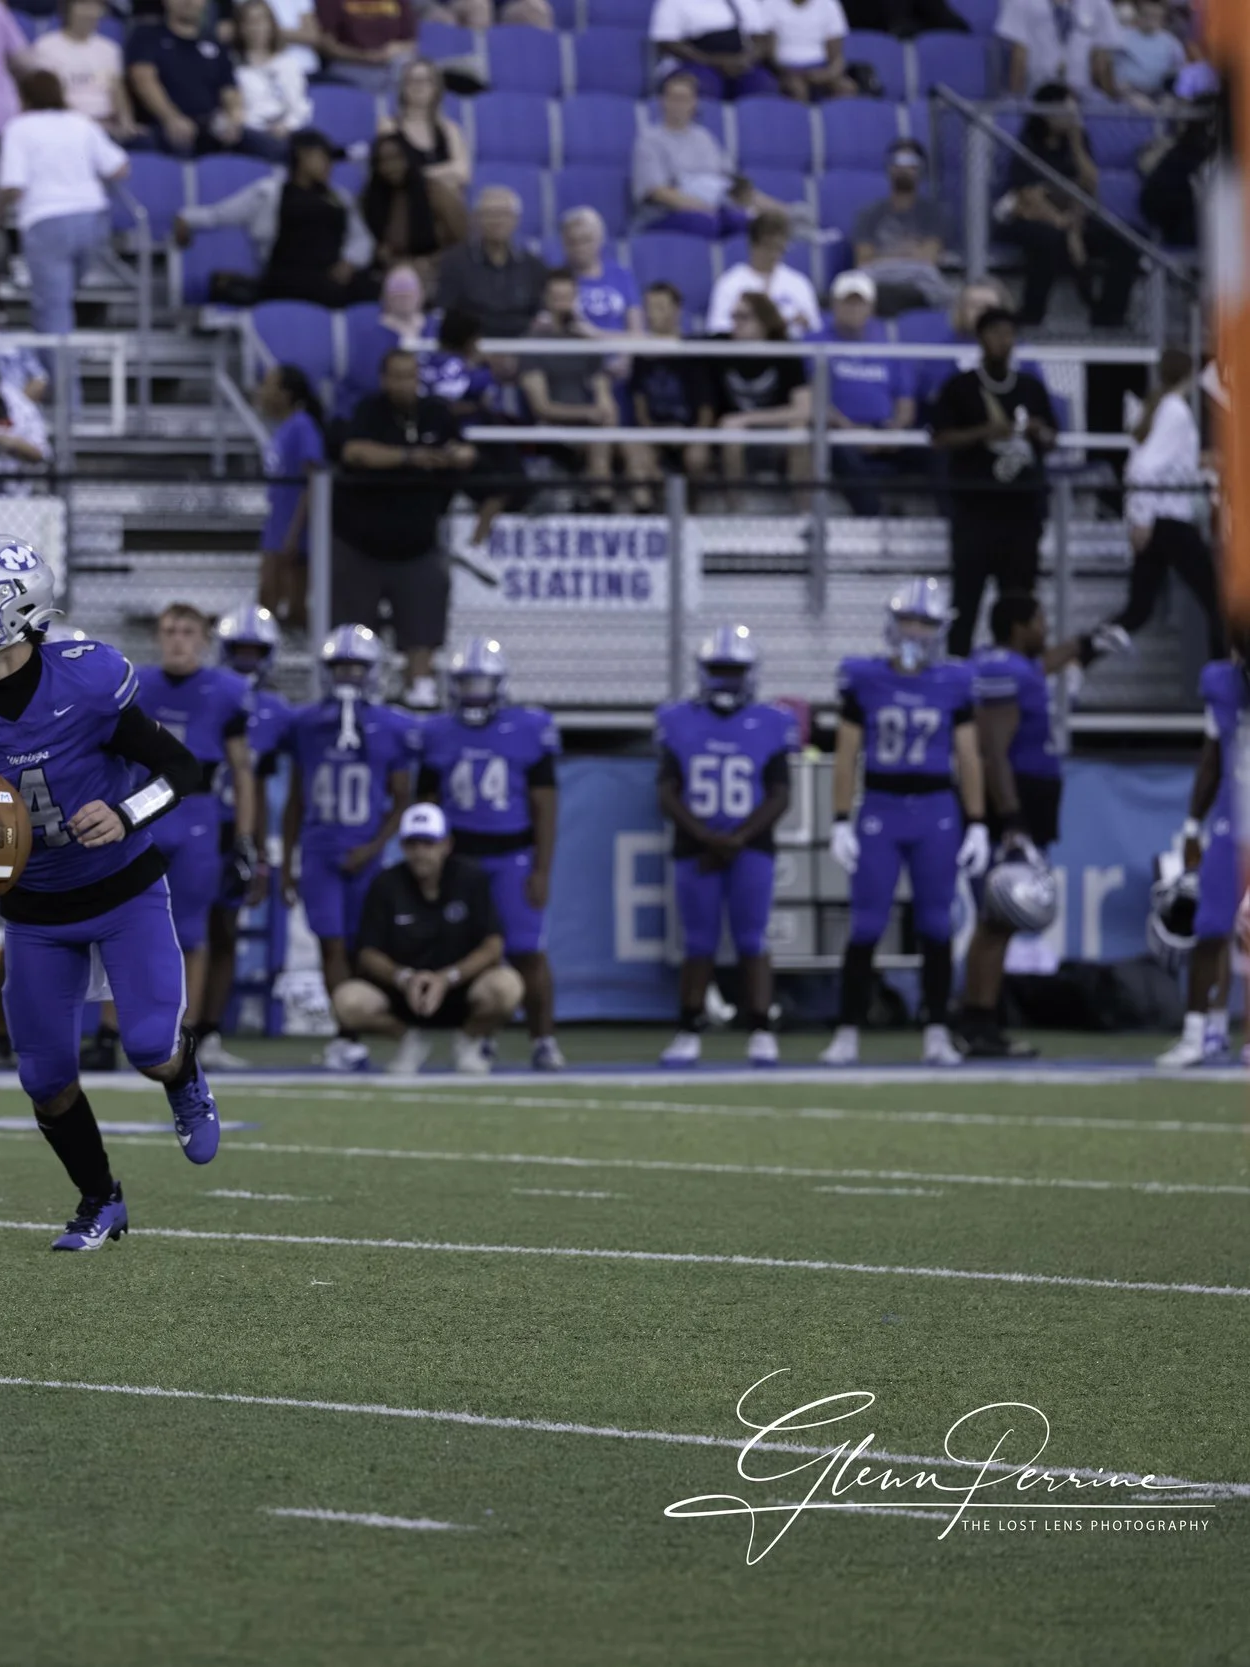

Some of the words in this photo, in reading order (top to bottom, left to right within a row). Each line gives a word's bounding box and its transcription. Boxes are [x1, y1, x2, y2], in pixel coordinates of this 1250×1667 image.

[488, 527, 667, 562] RESERVED
[504, 567, 653, 600] SEATING
[18, 766, 72, 849] 4
[312, 762, 371, 827] 40
[450, 756, 509, 812] 44
[687, 754, 755, 818] 56
